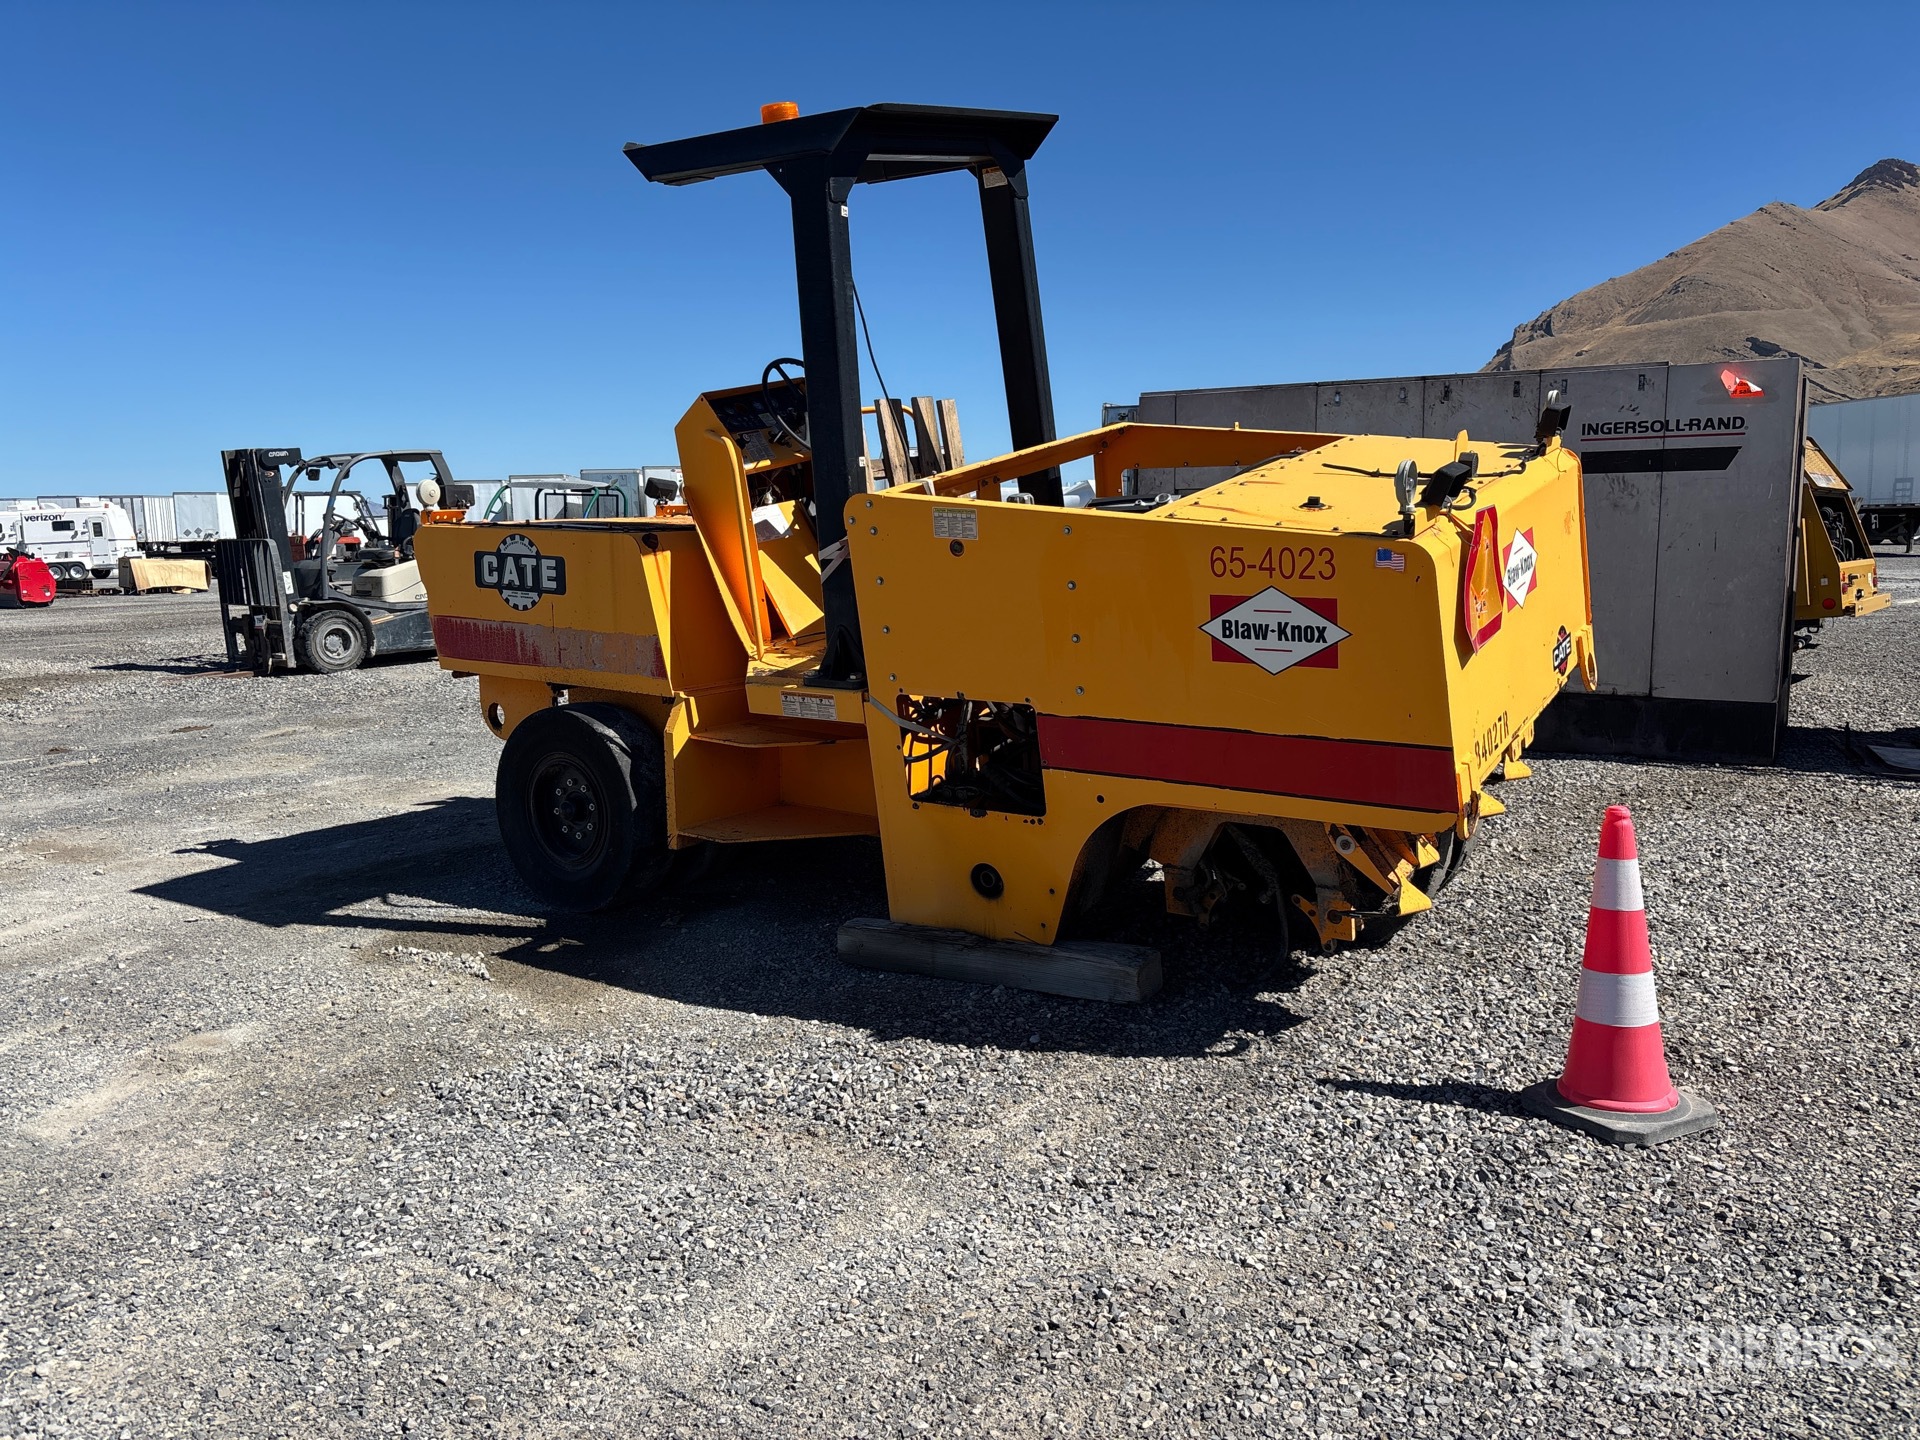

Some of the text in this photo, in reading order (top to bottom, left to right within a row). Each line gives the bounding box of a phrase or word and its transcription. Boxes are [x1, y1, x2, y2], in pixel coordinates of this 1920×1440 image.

[1581, 416, 1746, 436] INGERSOLL-RAND
[24, 513, 62, 522] verizon
[481, 555, 557, 591] CATE
[1210, 546, 1336, 581] 65-4023
[1506, 553, 1533, 588] Blaw-Knox
[1221, 619, 1328, 644] Blaw-Knox
[1553, 636, 1571, 667] CATE
